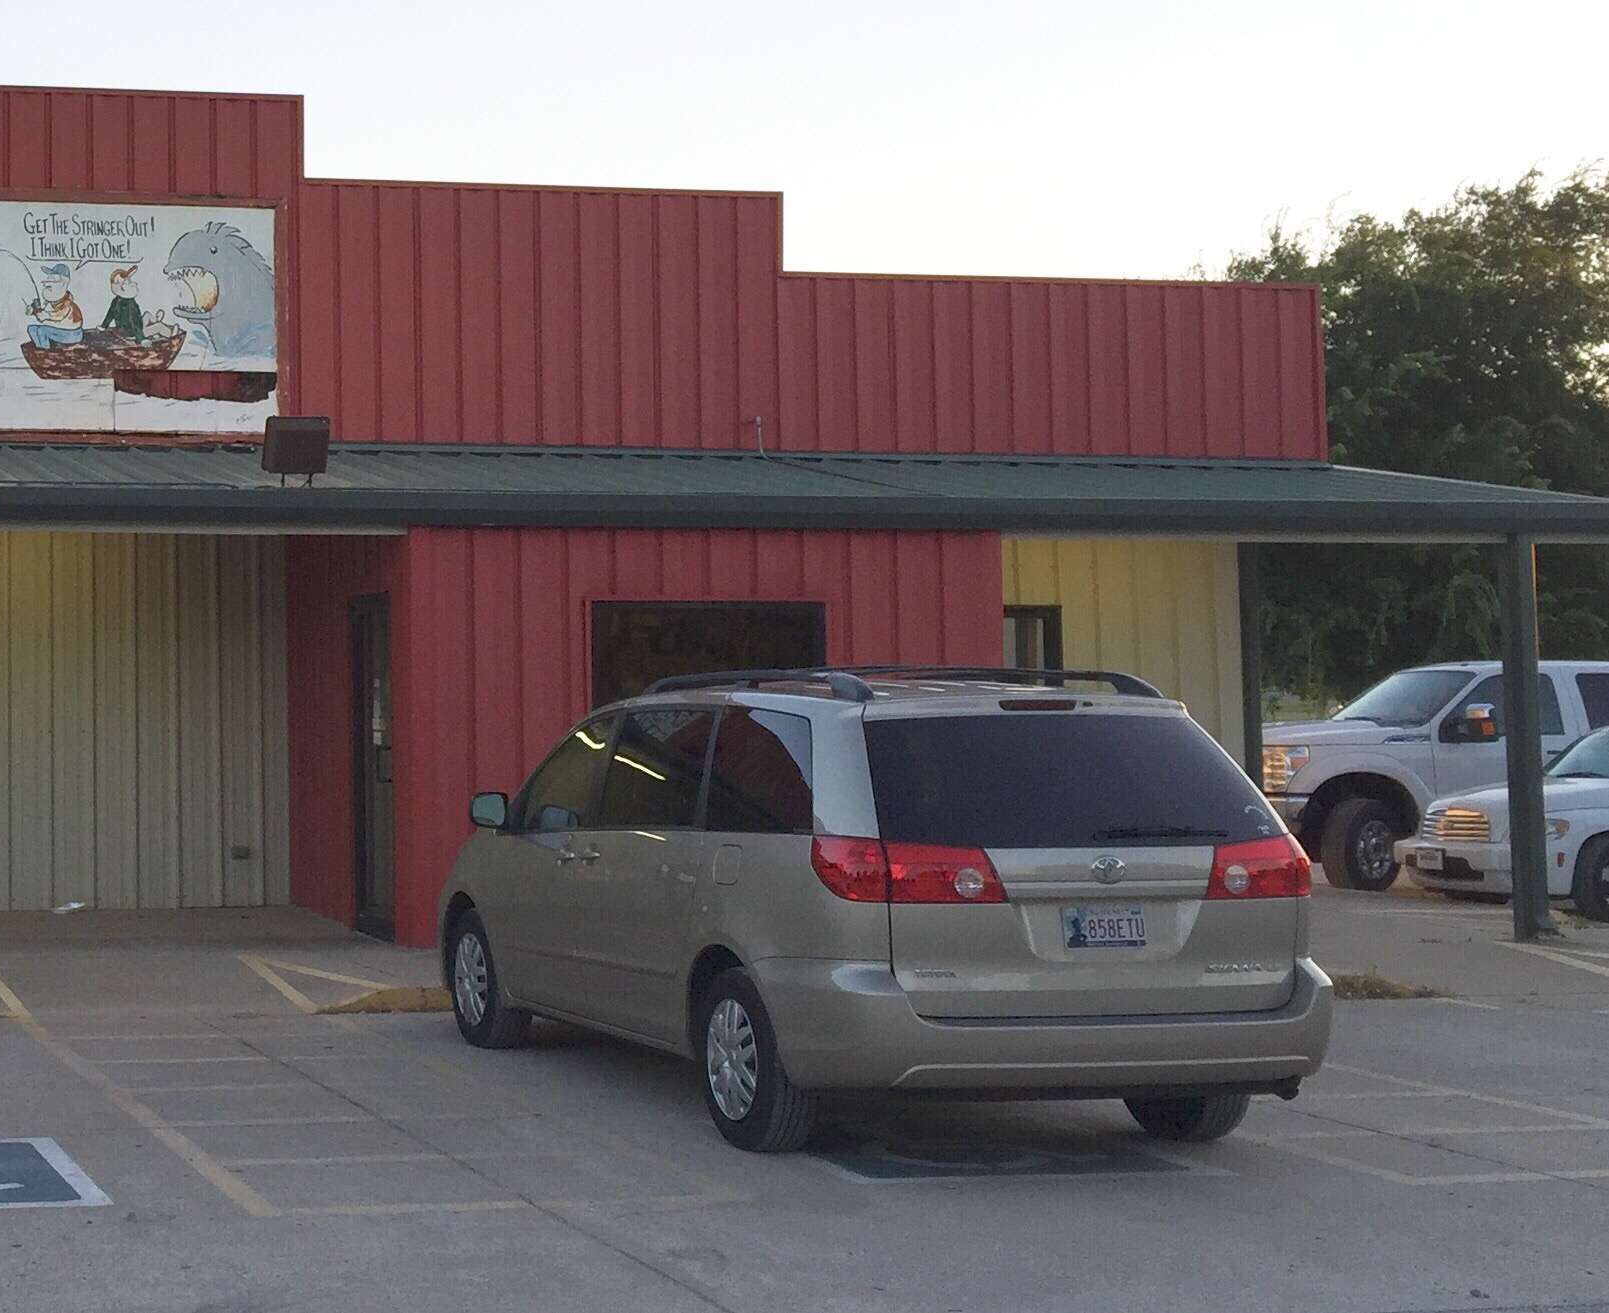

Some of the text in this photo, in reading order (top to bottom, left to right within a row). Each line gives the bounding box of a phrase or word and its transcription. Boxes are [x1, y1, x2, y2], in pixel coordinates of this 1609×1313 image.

[23, 212, 48, 234] GET
[49, 213, 70, 235] THE
[72, 213, 125, 237] STRINGER
[30, 237, 131, 259] I THINK I GOT ONE!
[1088, 918, 1146, 939] 858ETU
